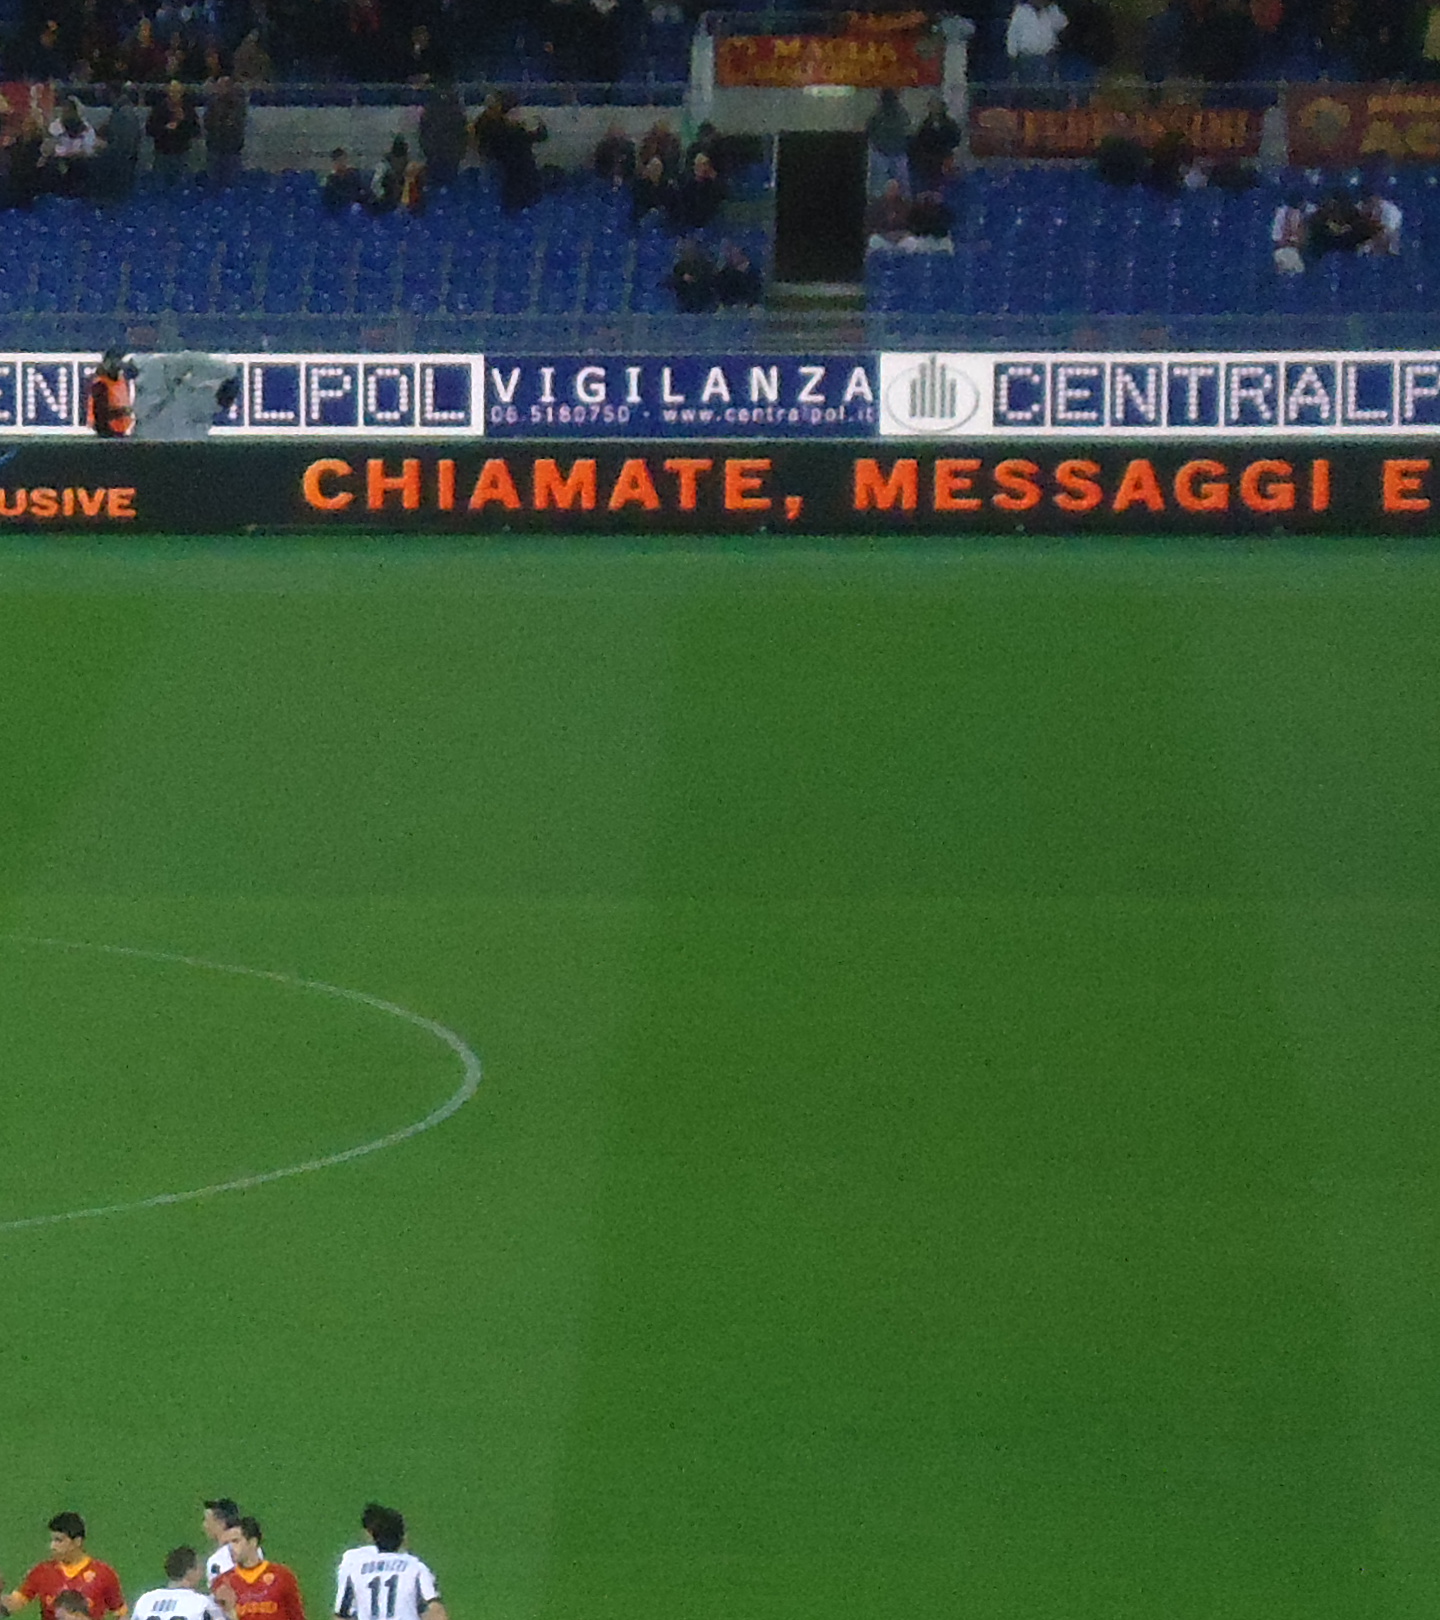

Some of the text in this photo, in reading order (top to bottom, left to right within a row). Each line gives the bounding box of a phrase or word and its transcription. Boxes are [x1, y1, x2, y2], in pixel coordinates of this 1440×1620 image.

[490, 365, 875, 403] VIGILANZA
[302, 457, 1431, 521] CHIAMATE, MESSAGGI E
[367, 1574, 400, 1620] 11
